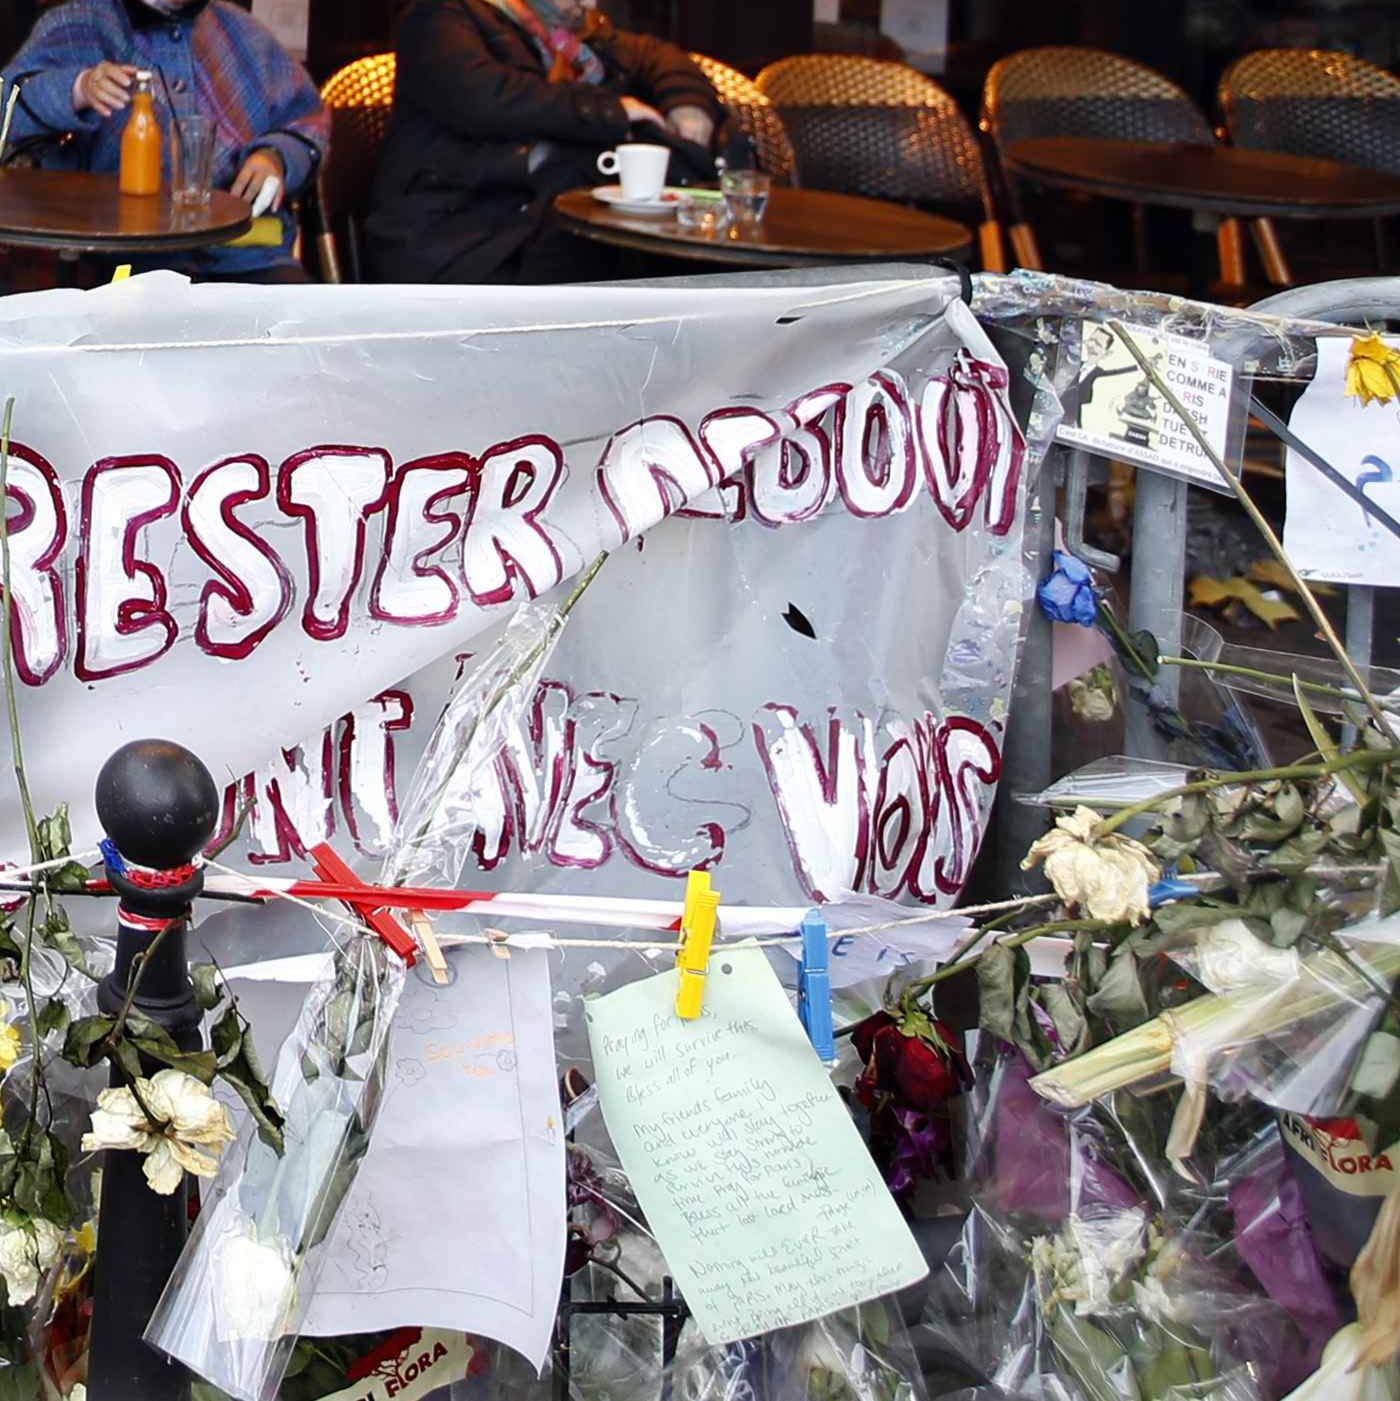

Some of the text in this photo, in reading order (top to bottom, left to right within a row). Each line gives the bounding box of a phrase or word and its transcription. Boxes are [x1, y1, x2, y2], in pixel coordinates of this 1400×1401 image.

[1168, 353, 1228, 382] EN SRIE
[1166, 370, 1228, 398] COMME A
[1162, 401, 1208, 425] DSH
[1160, 434, 1209, 459] DETRU
[384, 1341, 449, 1398] FLORA
